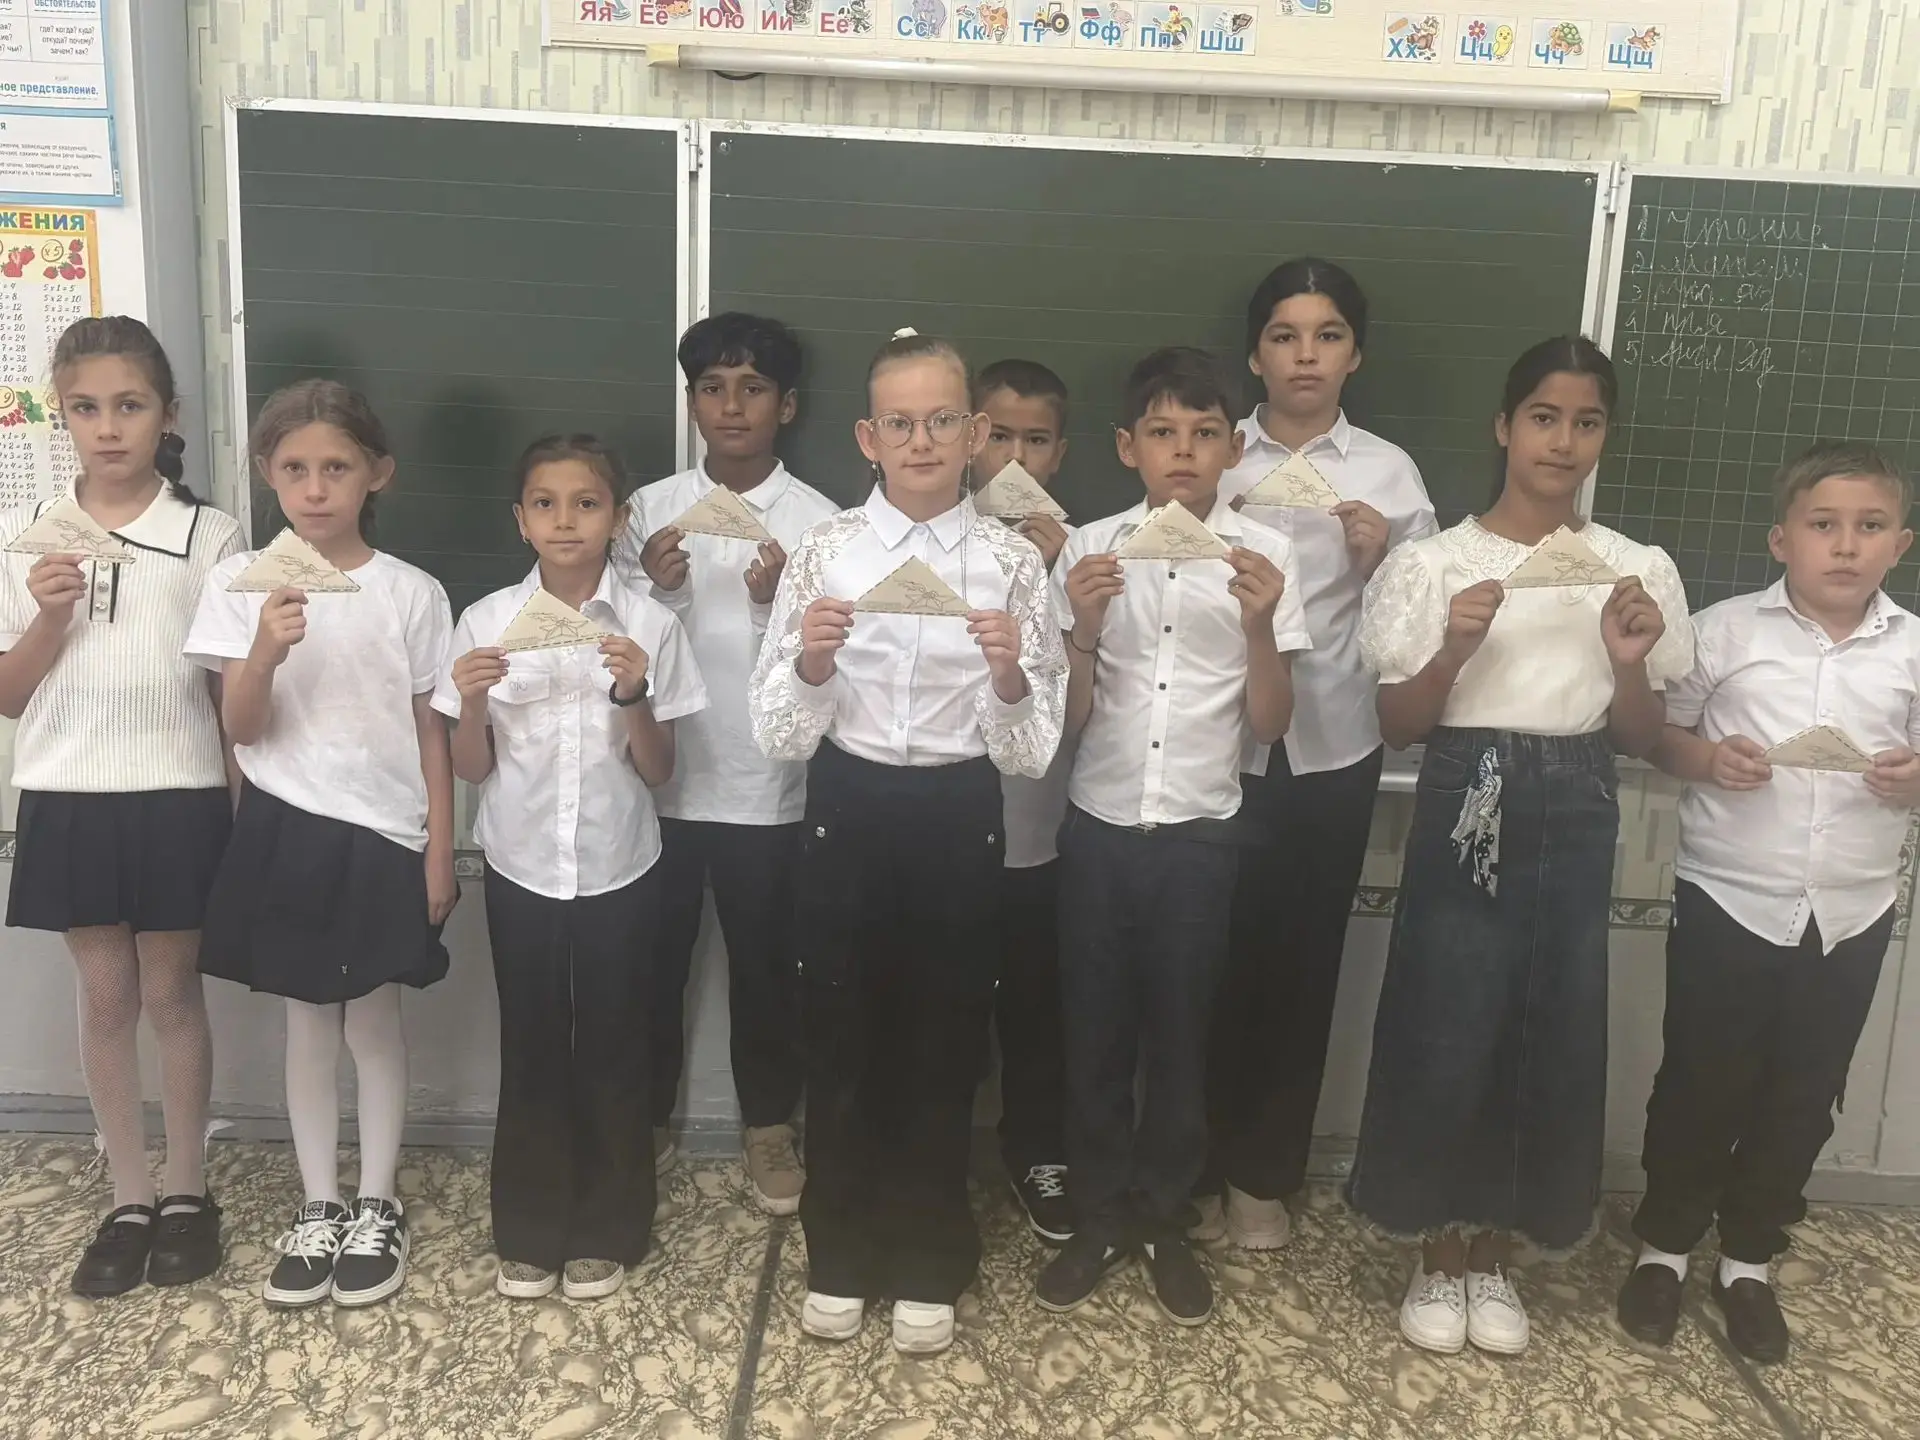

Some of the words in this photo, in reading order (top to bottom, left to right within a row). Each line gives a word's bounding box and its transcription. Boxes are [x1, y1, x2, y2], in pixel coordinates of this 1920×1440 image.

[580, 1, 612, 22] Яя
[640, 2, 669, 26] Ёё
[700, 7, 744, 29] Юю
[762, 10, 792, 31] Ии
[821, 14, 849, 33] Ее
[897, 16, 927, 37] Сс
[957, 19, 984, 40] Кк
[1019, 22, 1044, 43] Тт
[1079, 20, 1121, 46] Фф
[1140, 26, 1173, 48] Пп
[1200, 30, 1244, 52] Шш
[1387, 37, 1418, 59] Хх
[1460, 36, 1493, 61] Цц
[1535, 44, 1563, 65] Чч
[1608, 44, 1653, 69] Щщ
[20, 84, 99, 95] представление.
